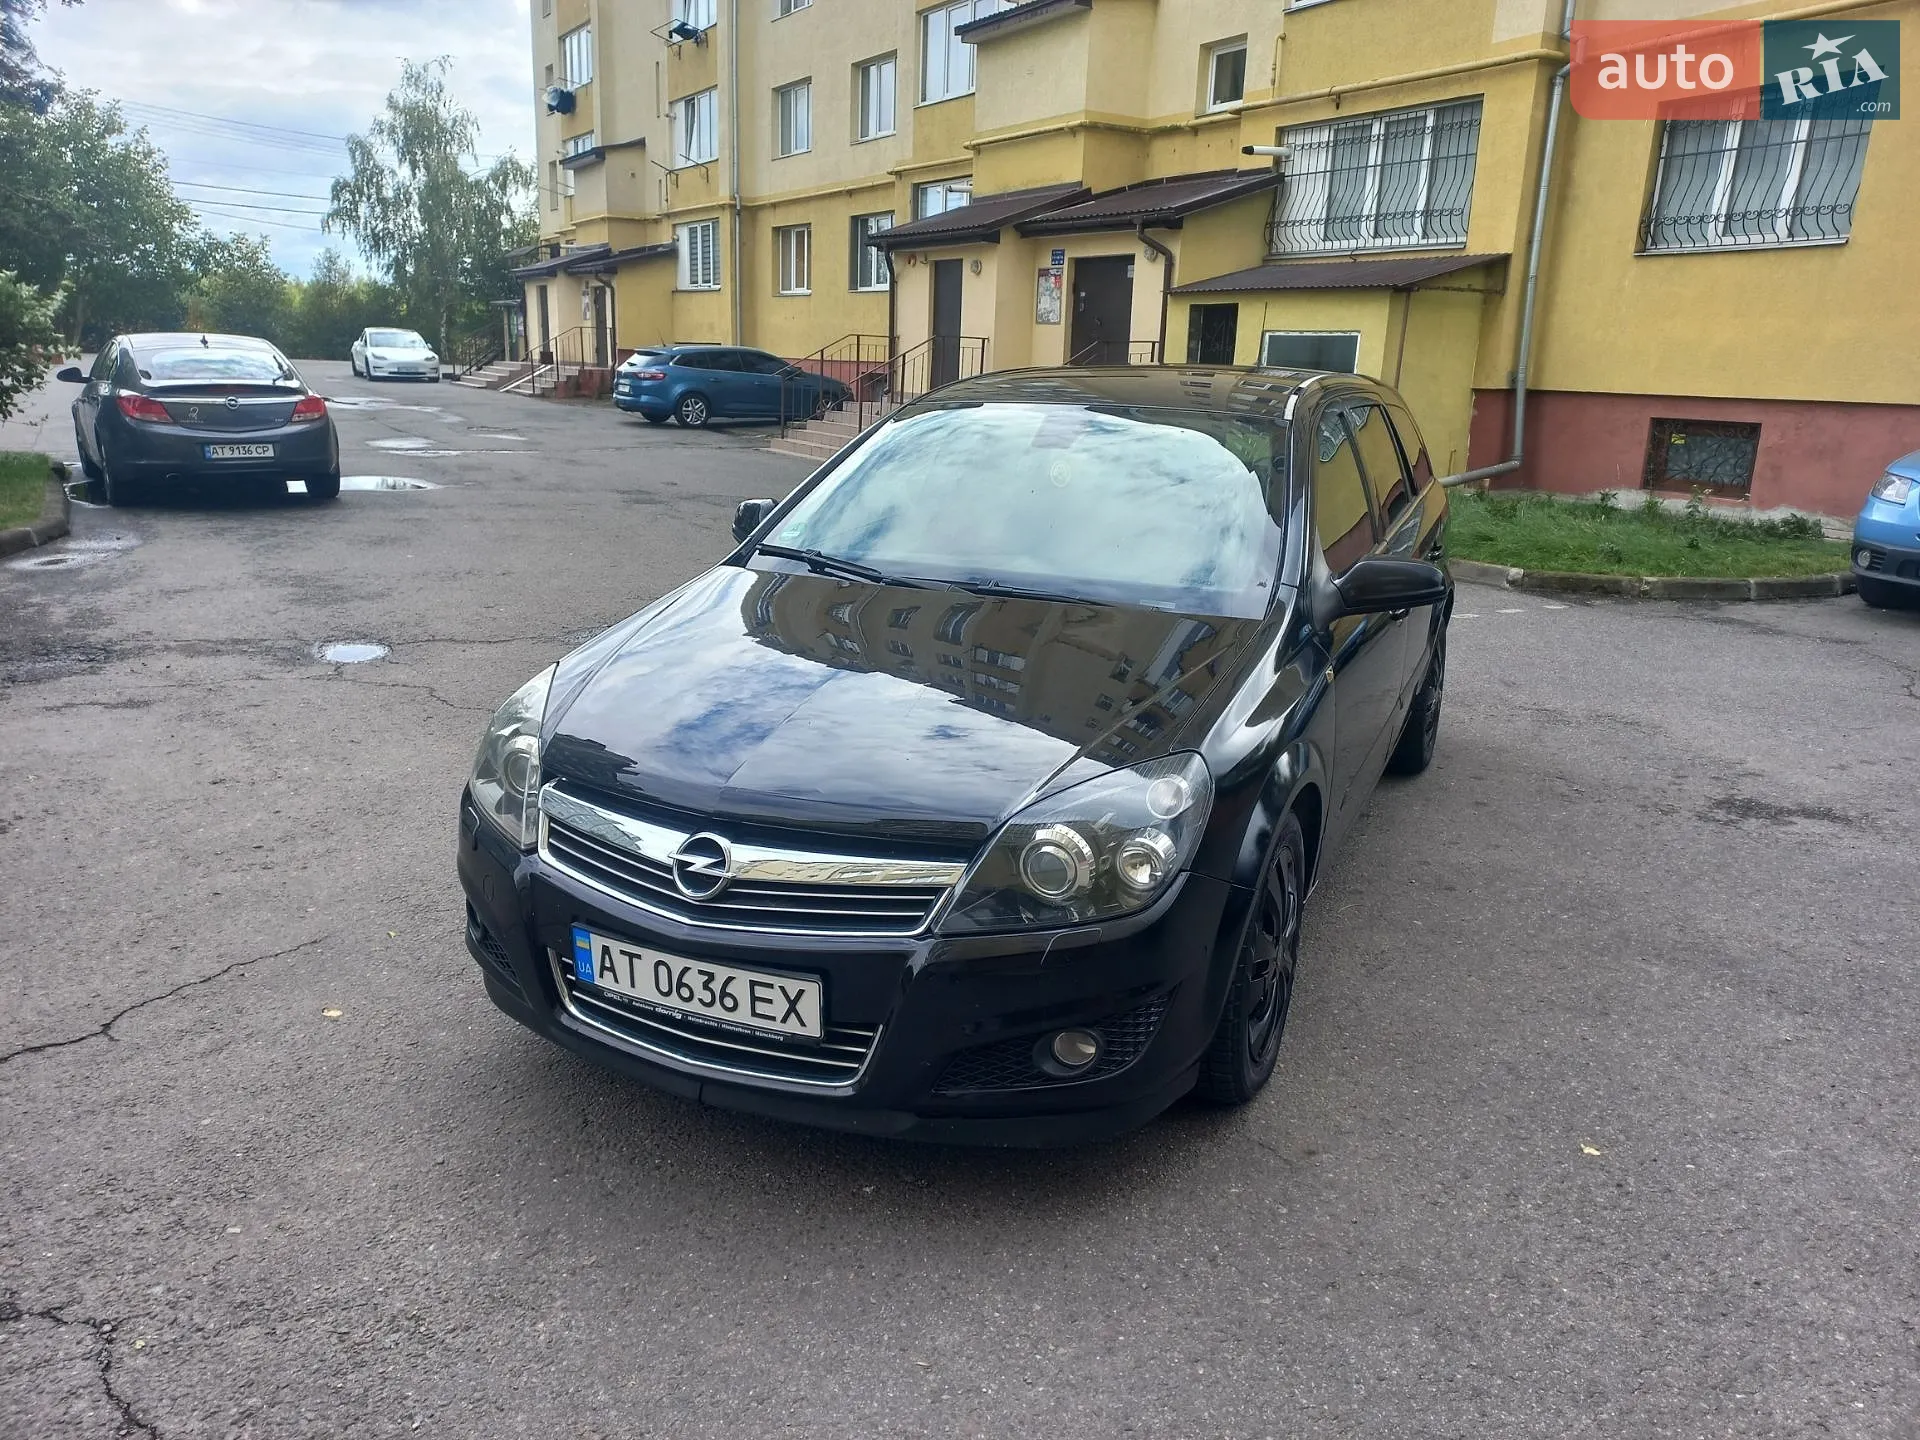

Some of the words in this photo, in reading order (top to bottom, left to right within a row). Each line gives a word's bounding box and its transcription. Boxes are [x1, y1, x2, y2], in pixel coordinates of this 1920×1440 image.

[211, 446, 226, 456] AT
[228, 446, 253, 456] 9136
[255, 445, 269, 455] CP
[578, 961, 593, 976] UA
[599, 944, 642, 989] AT
[653, 959, 739, 1013] 0636
[748, 979, 807, 1028] EX
